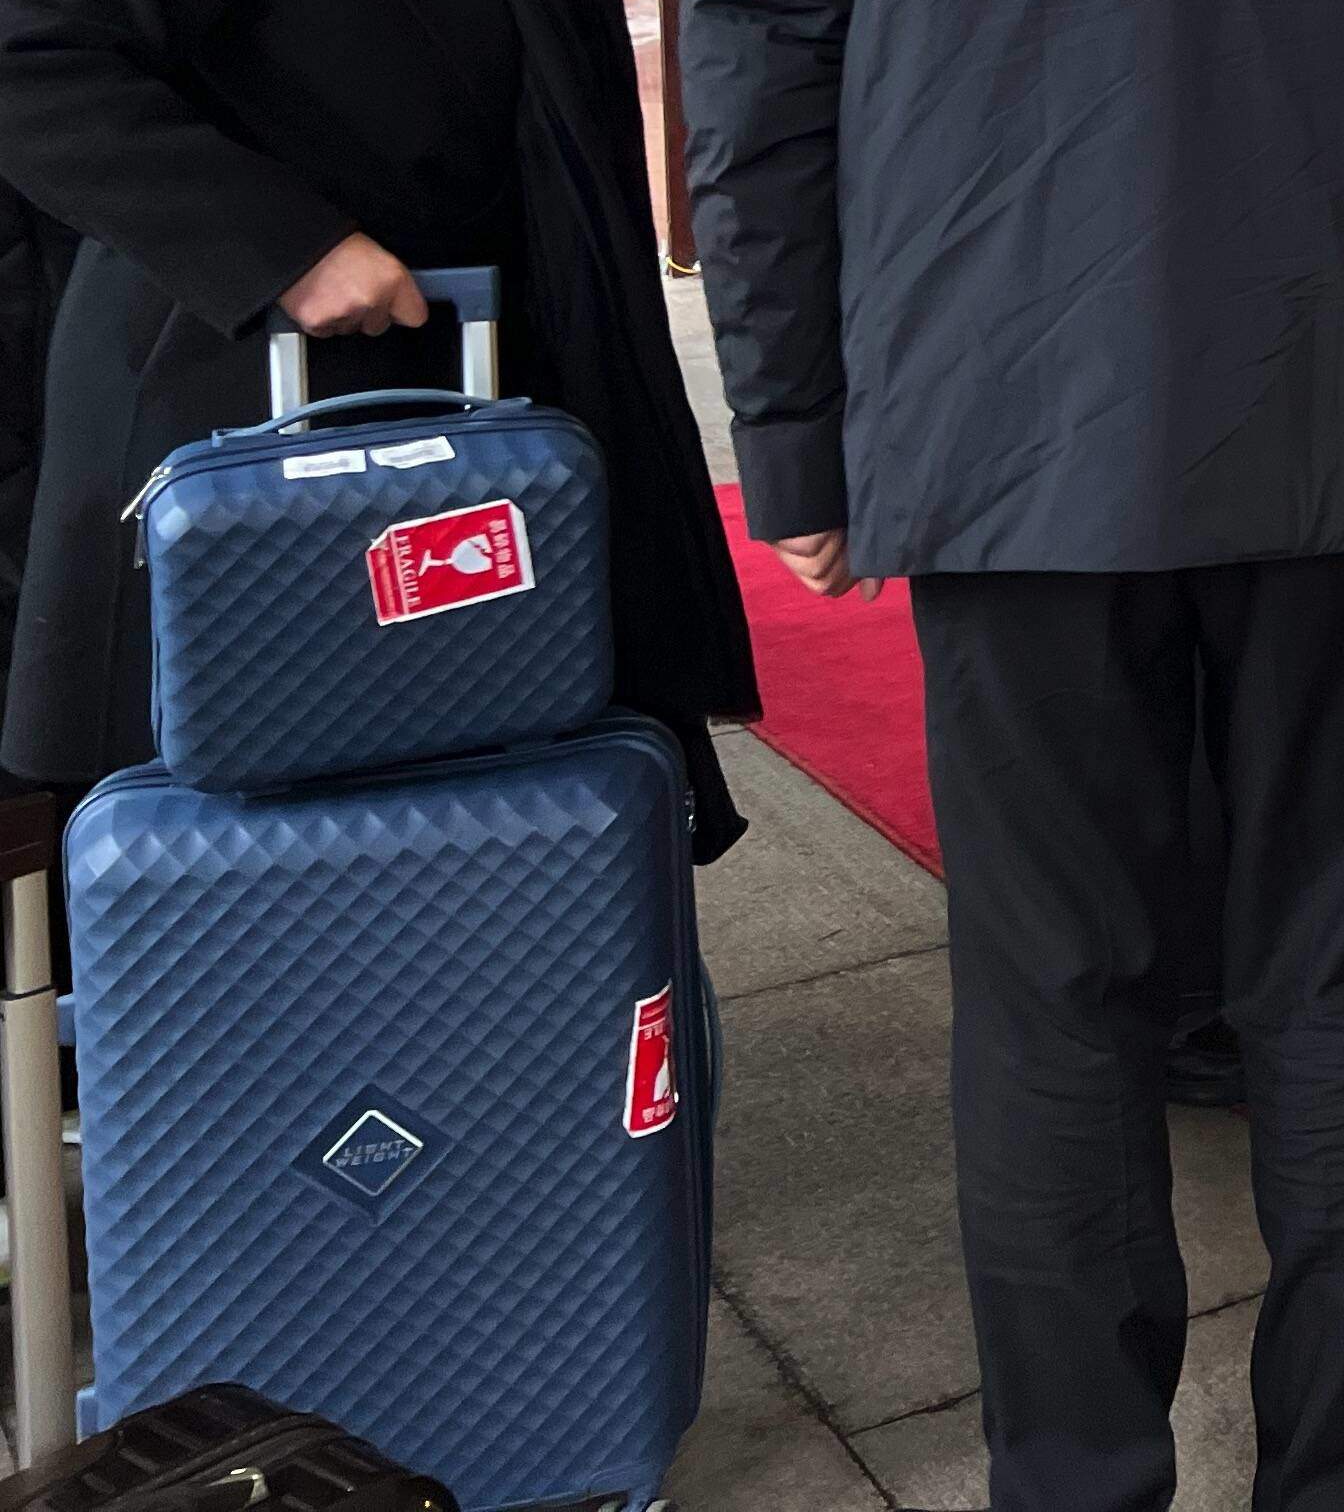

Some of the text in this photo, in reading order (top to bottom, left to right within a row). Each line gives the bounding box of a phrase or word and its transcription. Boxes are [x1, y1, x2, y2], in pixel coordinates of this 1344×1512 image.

[395, 534, 422, 610] FRAGILE
[335, 1147, 415, 1168] WEIGHT
[344, 1138, 406, 1158] LIGHT
